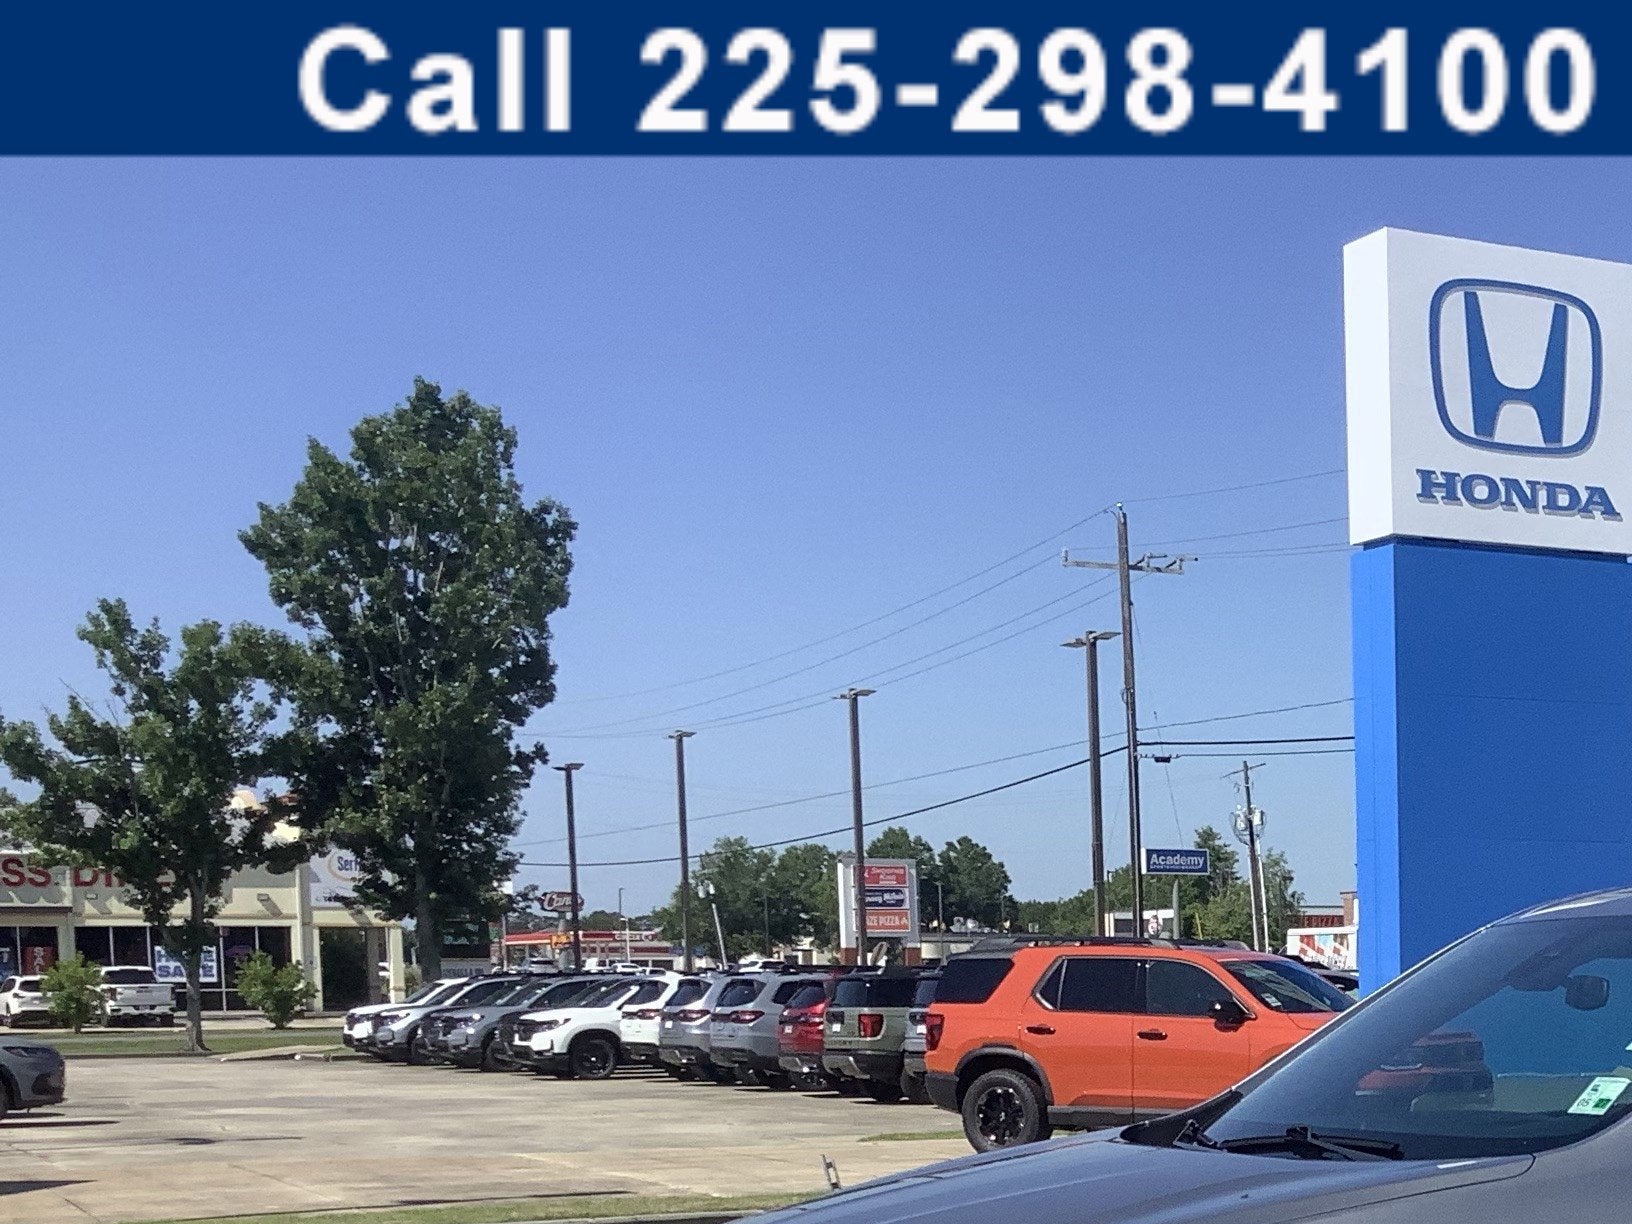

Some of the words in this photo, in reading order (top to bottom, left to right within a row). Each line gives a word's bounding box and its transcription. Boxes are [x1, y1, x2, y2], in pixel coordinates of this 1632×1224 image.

[1415, 468, 1623, 522] HONDA
[1150, 853, 1205, 869] Academy
[879, 915, 900, 926] PIZZA
